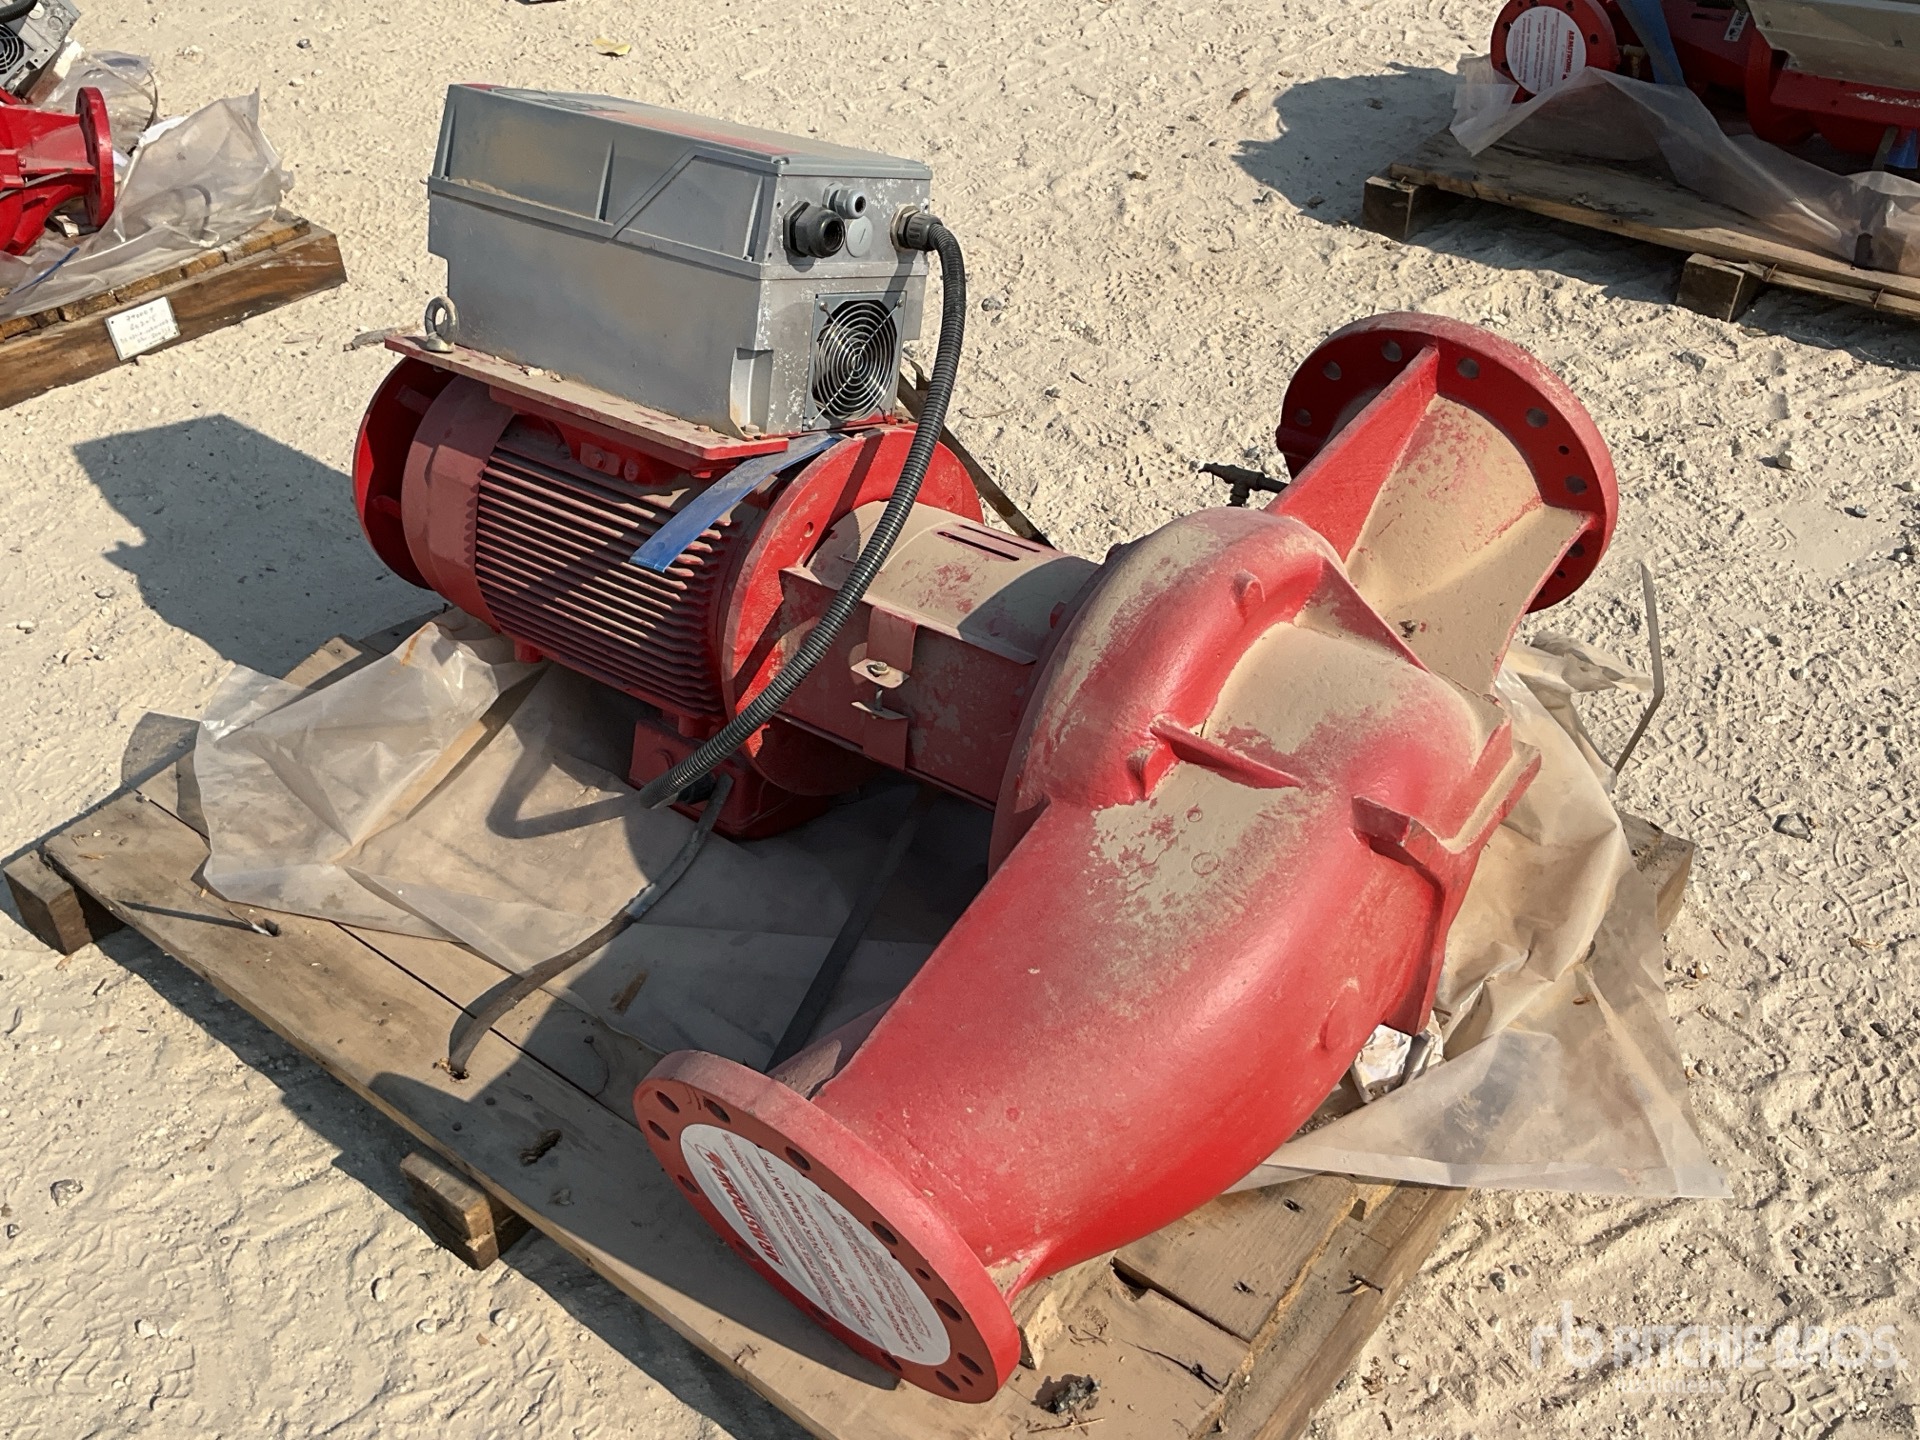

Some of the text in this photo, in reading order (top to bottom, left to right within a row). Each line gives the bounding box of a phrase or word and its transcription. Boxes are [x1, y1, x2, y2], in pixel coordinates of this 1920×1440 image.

[1565, 30, 1575, 73] ARMSTRONG
[763, 1156, 776, 1174] THE
[772, 1176, 785, 1191] ON
[712, 1168, 782, 1266] ARMSTRONG
[758, 1190, 776, 1218] BETTER
[782, 1192, 807, 1227] REMAIN
[795, 1194, 836, 1255] INSTALLATION
[806, 1230, 826, 1259] COVER
[825, 1262, 848, 1295] FLANGE
[833, 1256, 847, 1273] THE
[848, 1242, 878, 1287] FLUSHING
[846, 1278, 859, 1294] TILL
[874, 1288, 887, 1305] THE
[880, 1277, 904, 1315] BEFORE
[847, 1297, 870, 1330] ENSURE
[855, 1295, 874, 1321] PUMP
[884, 1307, 908, 1344] ENSURE
[900, 1316, 924, 1351] SYSTEM
